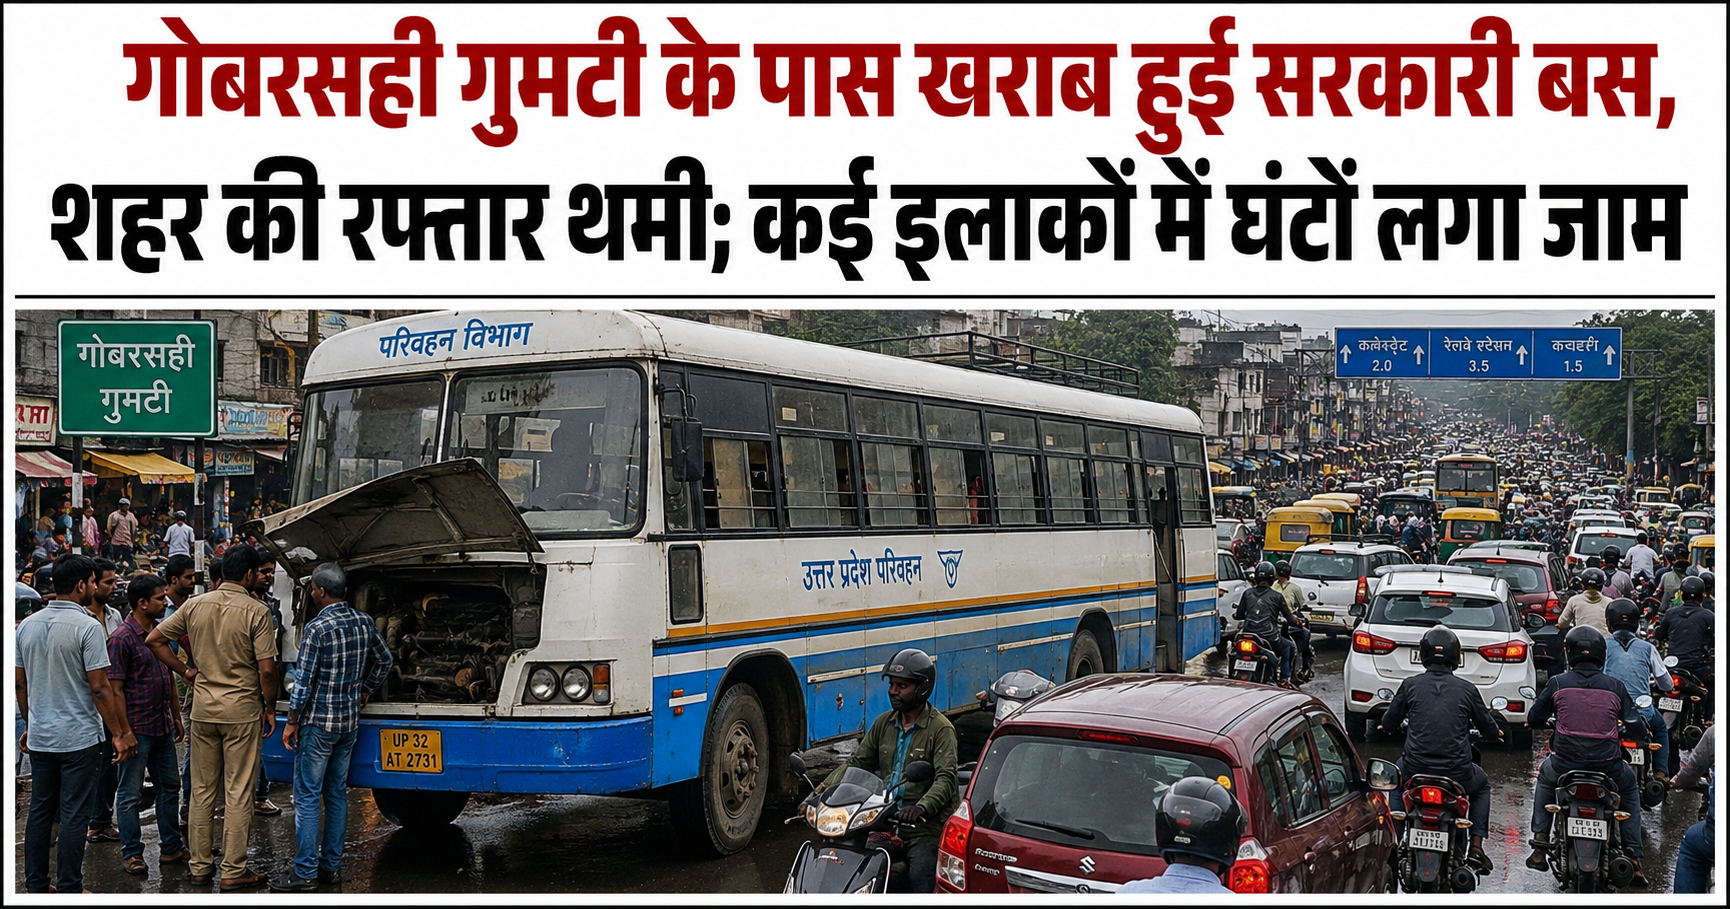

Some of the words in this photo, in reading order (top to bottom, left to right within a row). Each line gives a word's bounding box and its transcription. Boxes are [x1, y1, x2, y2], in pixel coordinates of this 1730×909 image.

[379, 326, 458, 358] परिवहन
[463, 318, 534, 350] विभाग
[76, 333, 197, 372] गोबरसही
[1372, 359, 1392, 372] 2.0
[1468, 359, 1490, 372] 3.5
[1563, 359, 1583, 373] 1.5
[99, 378, 173, 424] गुमटी
[801, 560, 835, 591] उत्तर
[838, 549, 872, 589] प्रदेश
[875, 547, 922, 585] परिवहन
[393, 733, 409, 747] UP
[413, 733, 428, 748] 32
[386, 752, 402, 767] AT
[406, 753, 437, 768] 2731
